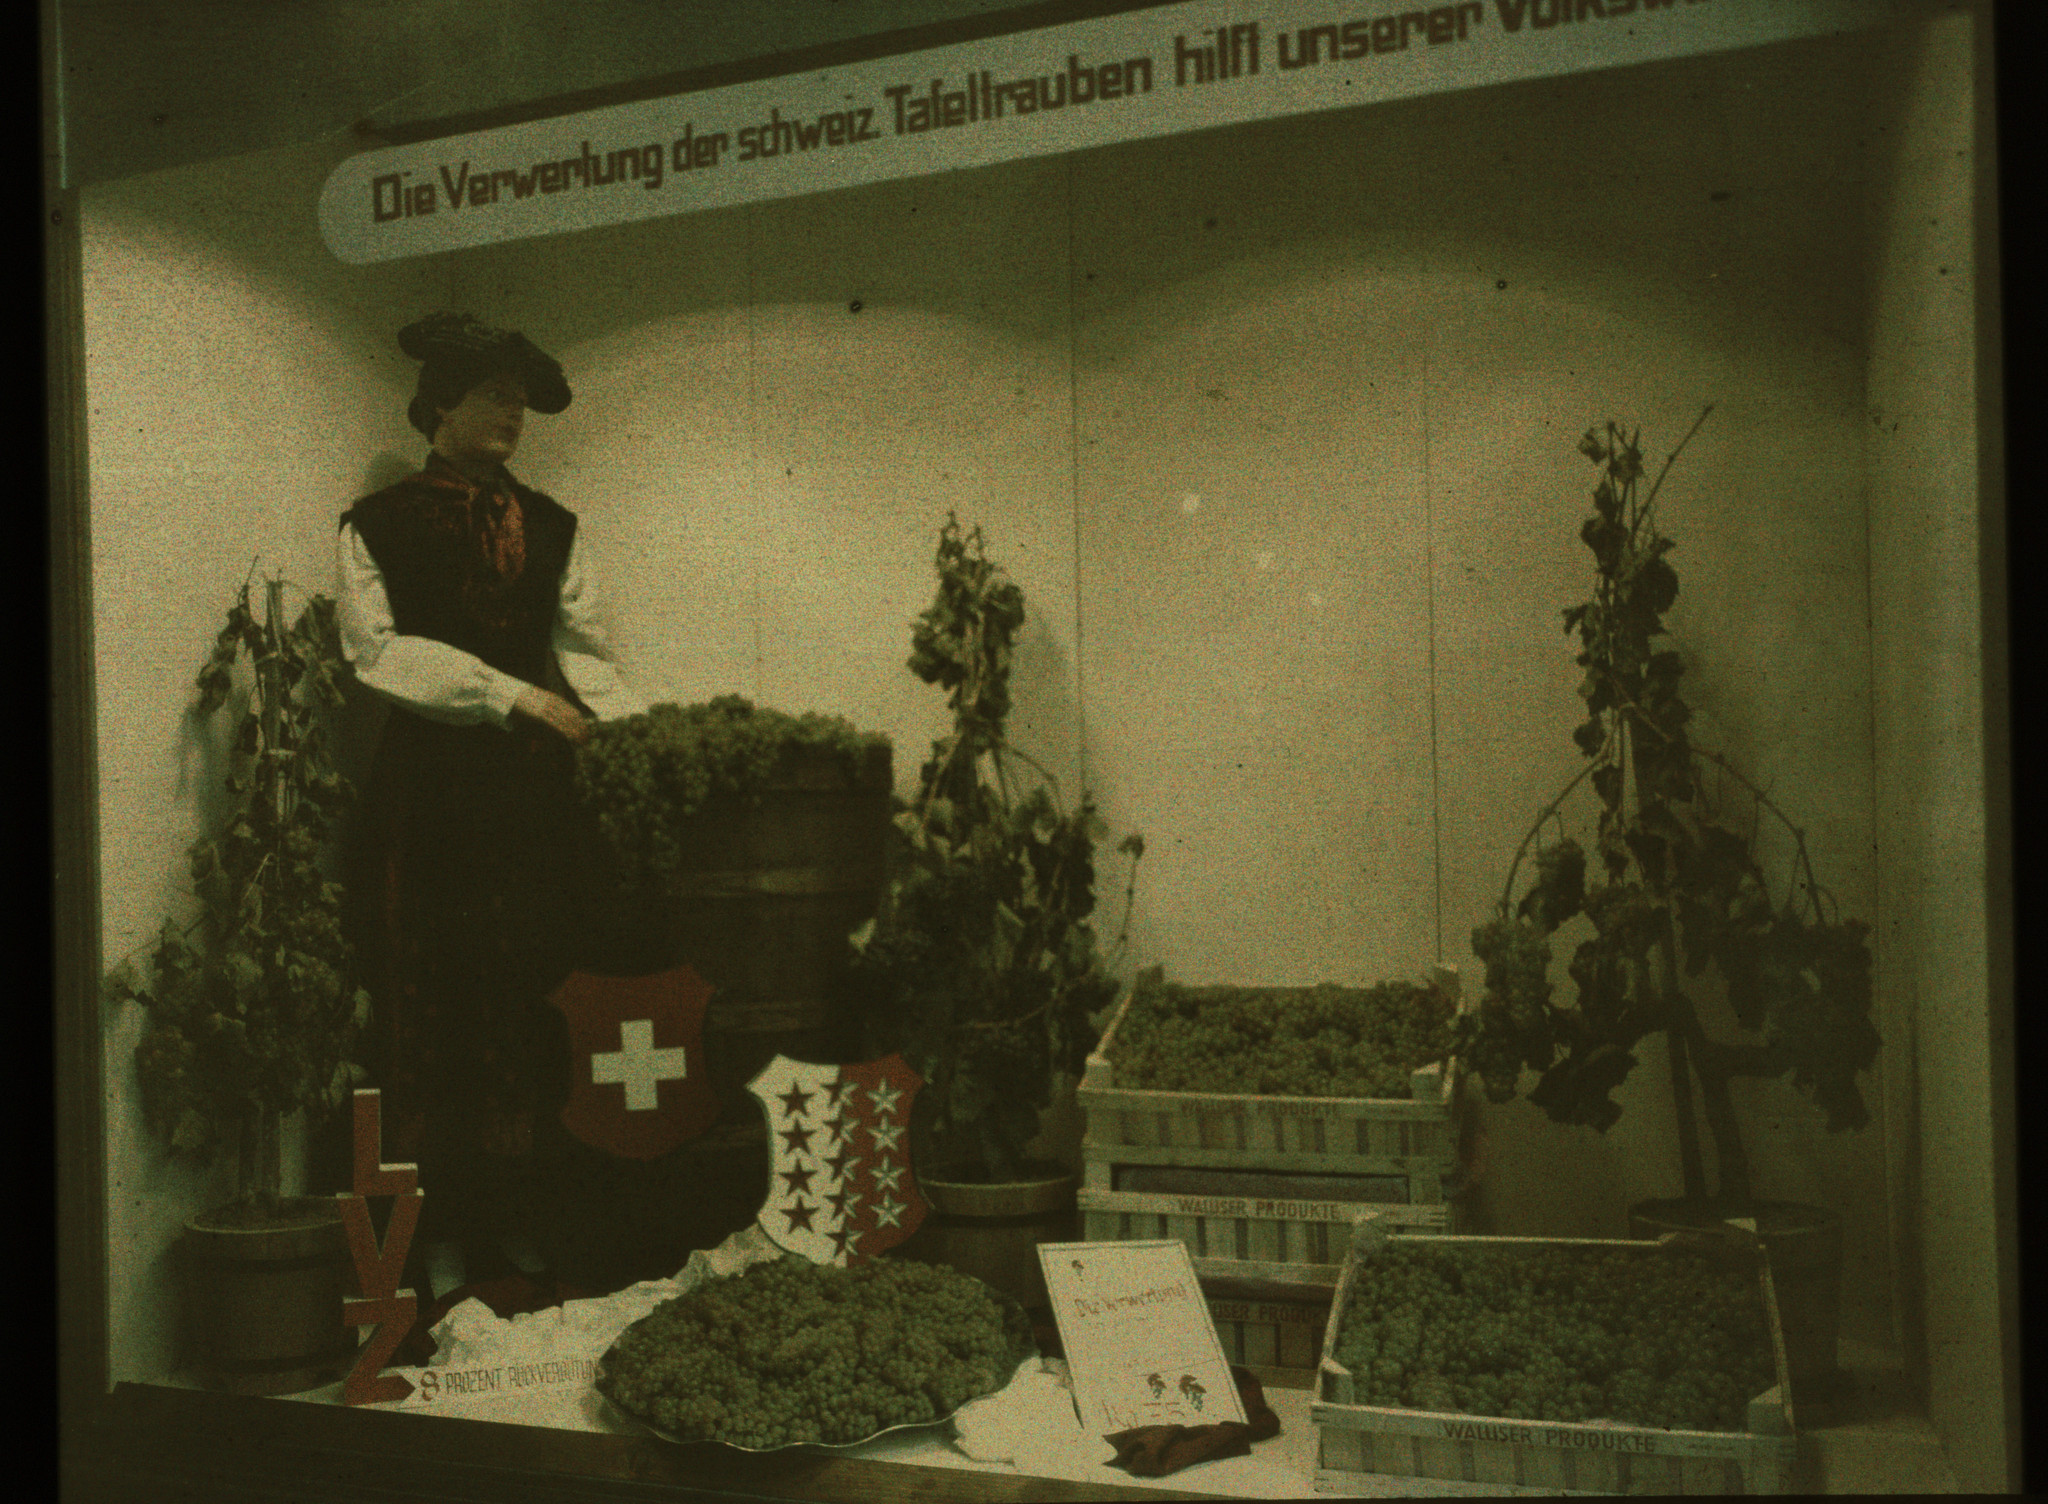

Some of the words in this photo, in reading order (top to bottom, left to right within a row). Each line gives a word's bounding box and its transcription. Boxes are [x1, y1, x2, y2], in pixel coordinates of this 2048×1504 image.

[372, 172, 437, 224] Die
[438, 141, 664, 212] Verwertung
[671, 122, 729, 173] der
[737, 107, 881, 163] schweiz.
[884, 56, 1154, 137] Tafeltrauben
[1174, 22, 1260, 88] hilft
[1278, 1, 1484, 71] unserer
[1255, 1201, 1341, 1219] PRODUKTE
[420, 1370, 440, 1402] 8
[445, 1368, 502, 1395] PROZENT
[1442, 1421, 1532, 1443] WALLISER
[1546, 1429, 1657, 1453] PRODUKTE
